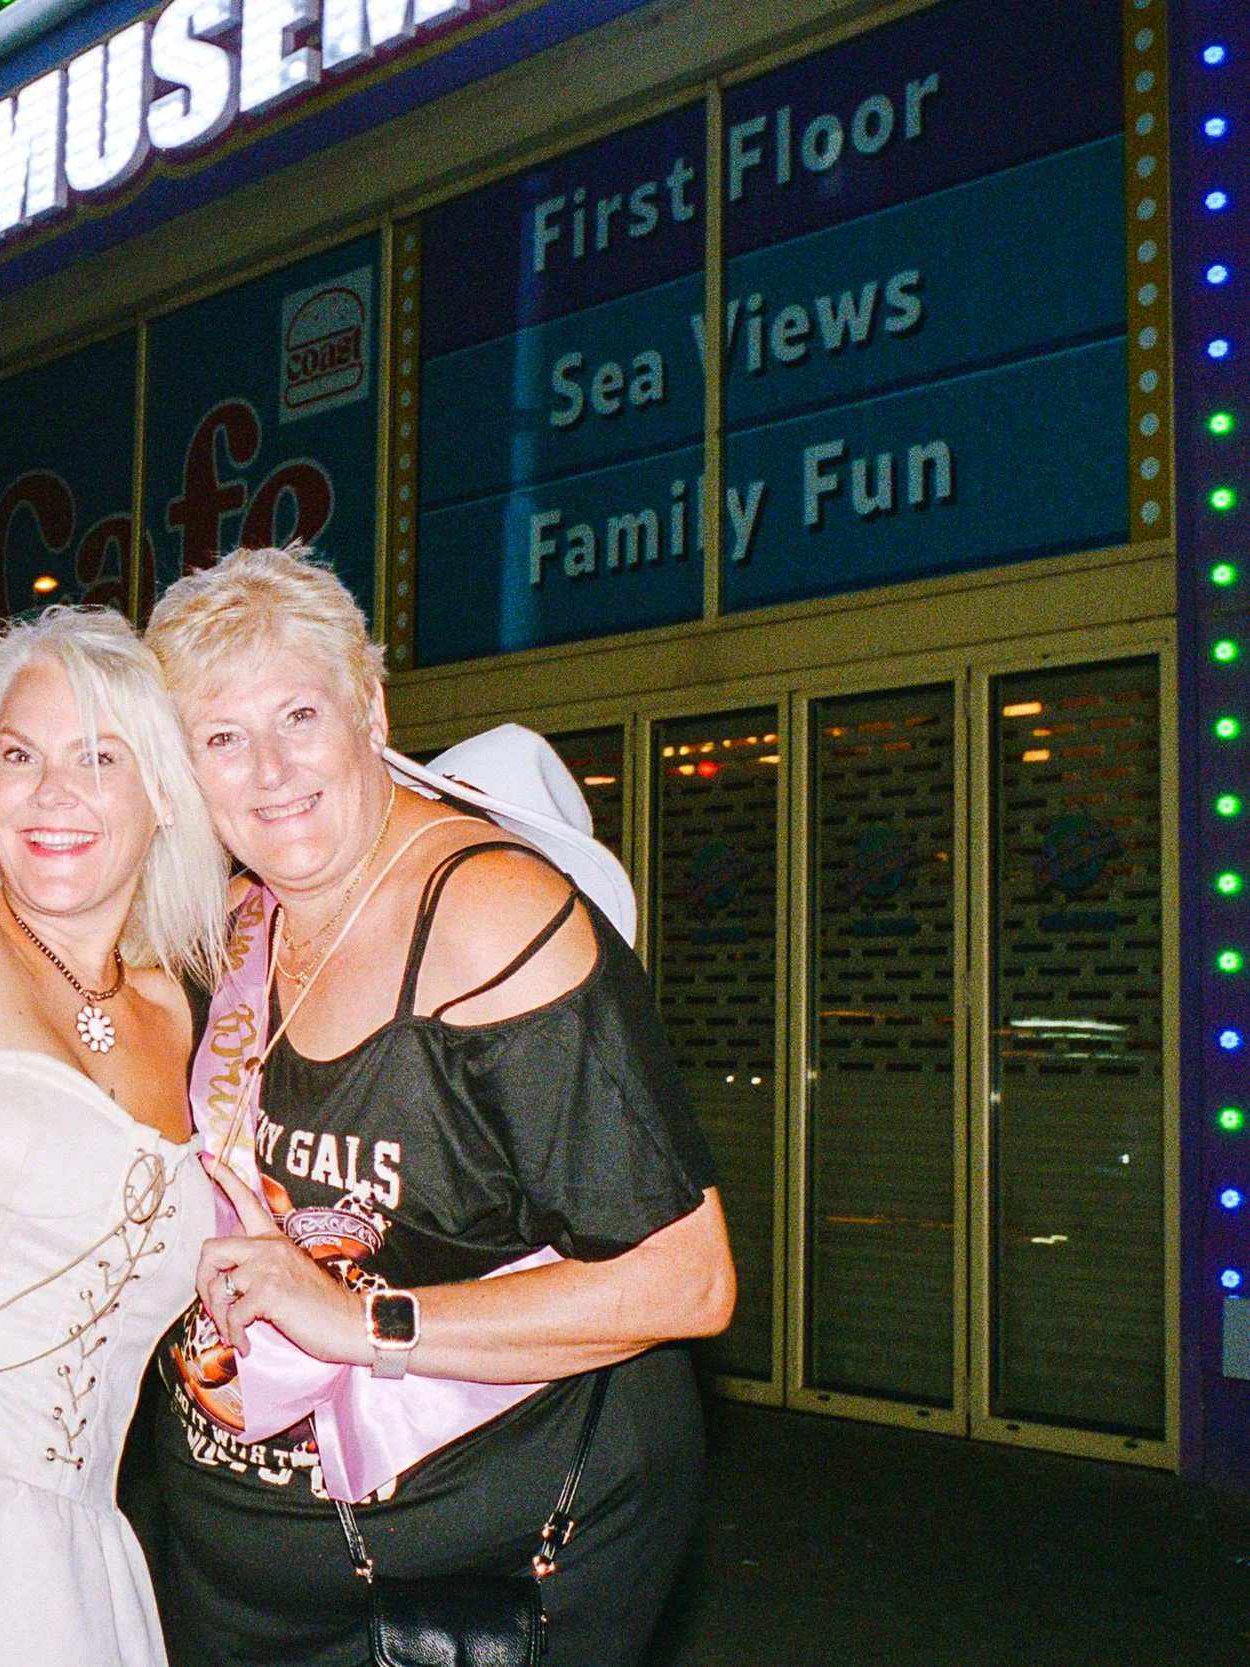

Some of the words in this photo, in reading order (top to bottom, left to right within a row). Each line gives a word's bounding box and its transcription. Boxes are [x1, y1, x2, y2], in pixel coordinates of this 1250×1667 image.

[532, 156, 695, 273] First
[727, 72, 940, 201] Floor
[549, 348, 666, 429] Sea
[803, 437, 953, 527] Fun
[286, 1129, 401, 1211] GALS
[191, 1411, 208, 1432] IT
